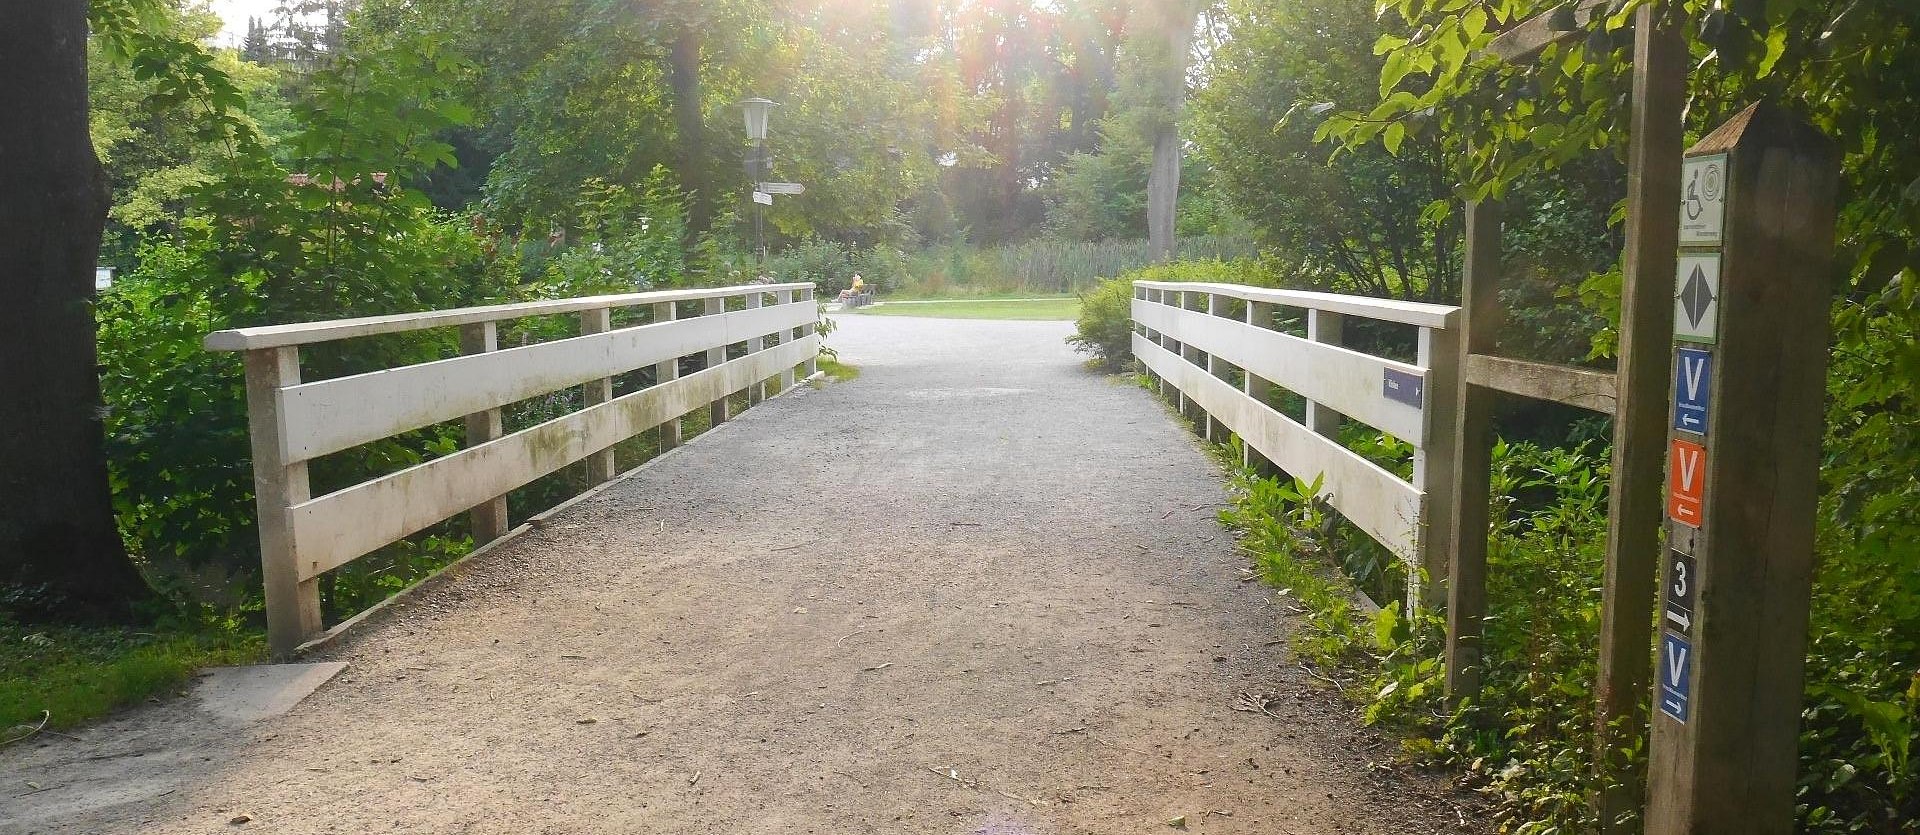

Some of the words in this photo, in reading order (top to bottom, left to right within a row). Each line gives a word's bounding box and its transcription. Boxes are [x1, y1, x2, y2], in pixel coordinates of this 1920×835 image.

[1684, 356, 1704, 400] V
[1679, 447, 1698, 492] V
[1674, 561, 1687, 597] 3
[1668, 641, 1687, 687] V
